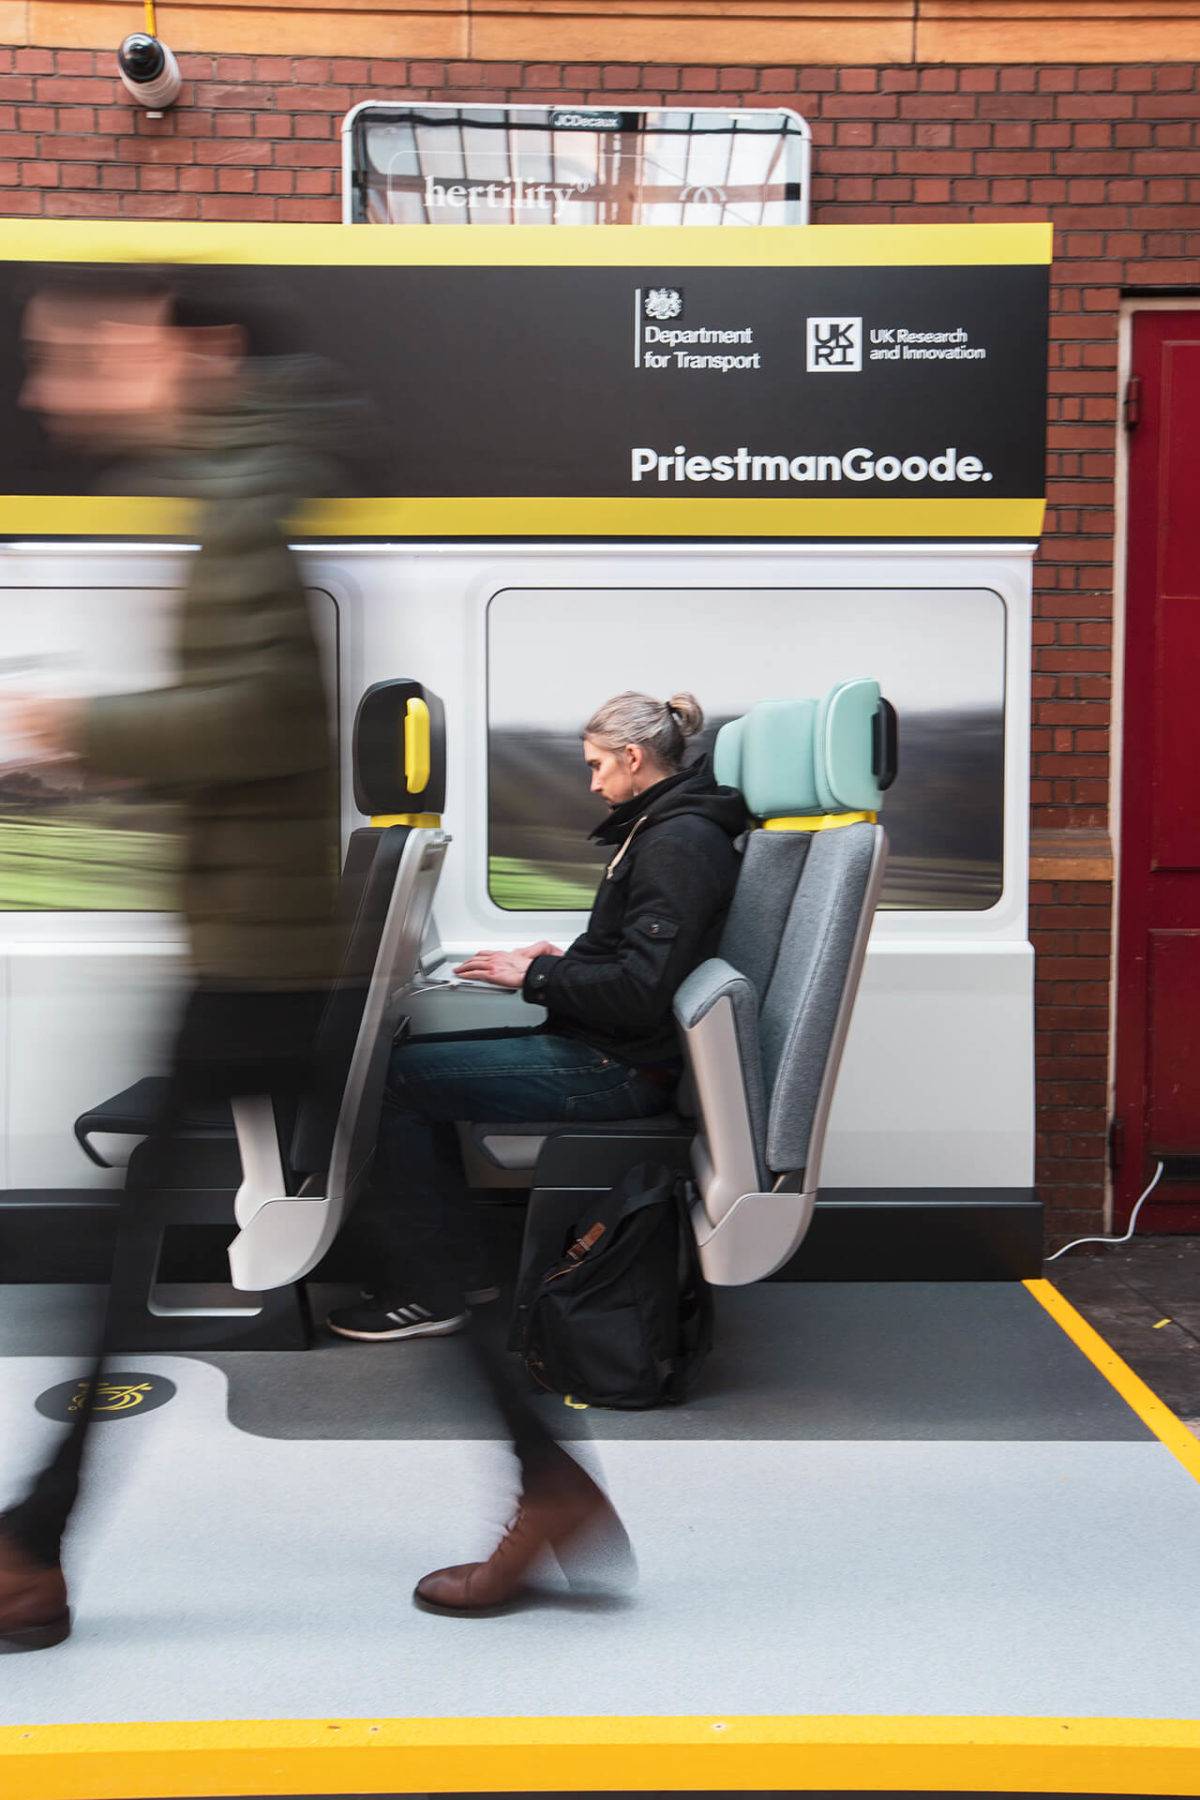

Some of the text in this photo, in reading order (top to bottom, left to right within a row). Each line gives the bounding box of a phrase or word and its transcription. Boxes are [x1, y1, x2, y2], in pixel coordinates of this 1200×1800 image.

[554, 114, 619, 128] JCDecaux
[644, 326, 753, 347] Department
[814, 323, 855, 346] UK
[870, 328, 968, 343] UK Research
[644, 351, 761, 373] for Transport
[814, 346, 854, 366] RI
[870, 346, 986, 360] and Innovation
[631, 445, 993, 482] PriestmanGoode.
